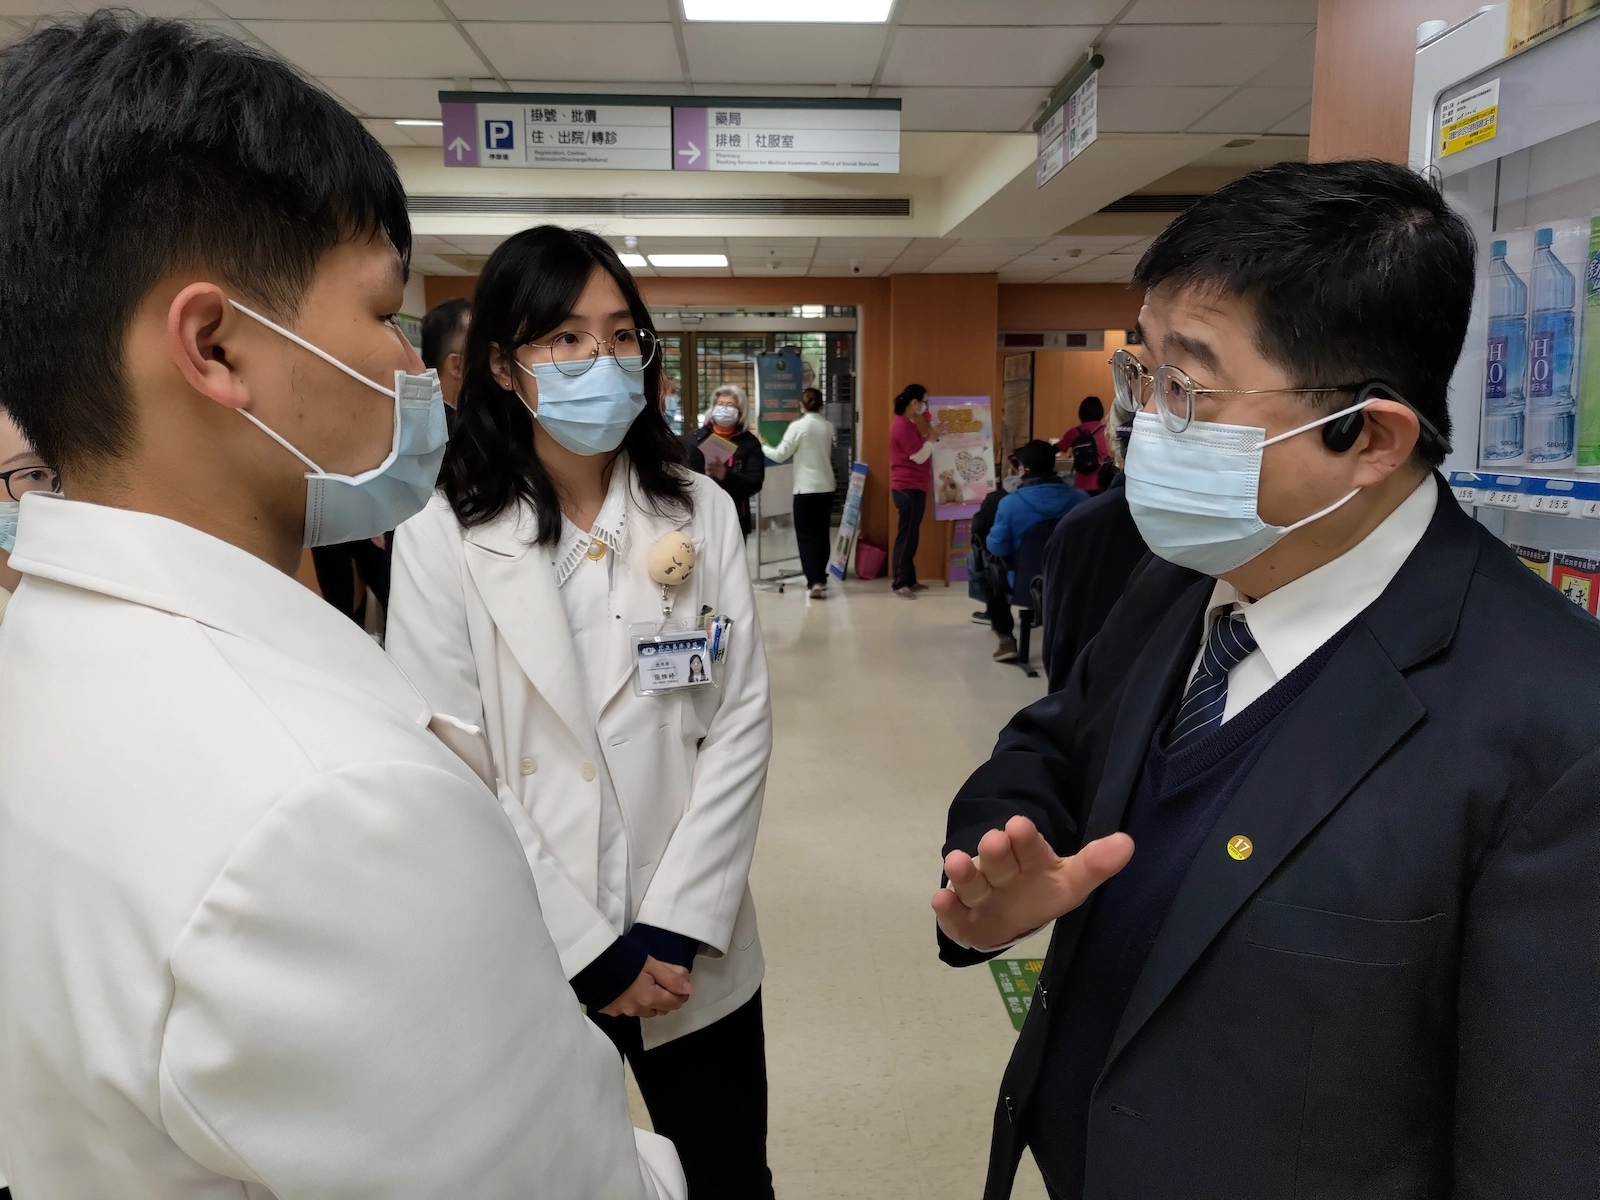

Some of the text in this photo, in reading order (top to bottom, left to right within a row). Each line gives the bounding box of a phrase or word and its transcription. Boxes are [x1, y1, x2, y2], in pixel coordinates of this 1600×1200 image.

[530, 108, 597, 124] 掛號、批價
[715, 112, 742, 126] 藥局
[489, 122, 510, 148] P
[531, 130, 618, 145] 住、出院/轉診
[715, 134, 794, 149] 排檢 社服室
[1490, 492, 1495, 501] 2
[1501, 494, 1518, 502] 25元
[1536, 498, 1542, 507] 3
[1549, 500, 1569, 509] 25元
[1590, 504, 1596, 513] 4
[1234, 838, 1250, 852] 17
